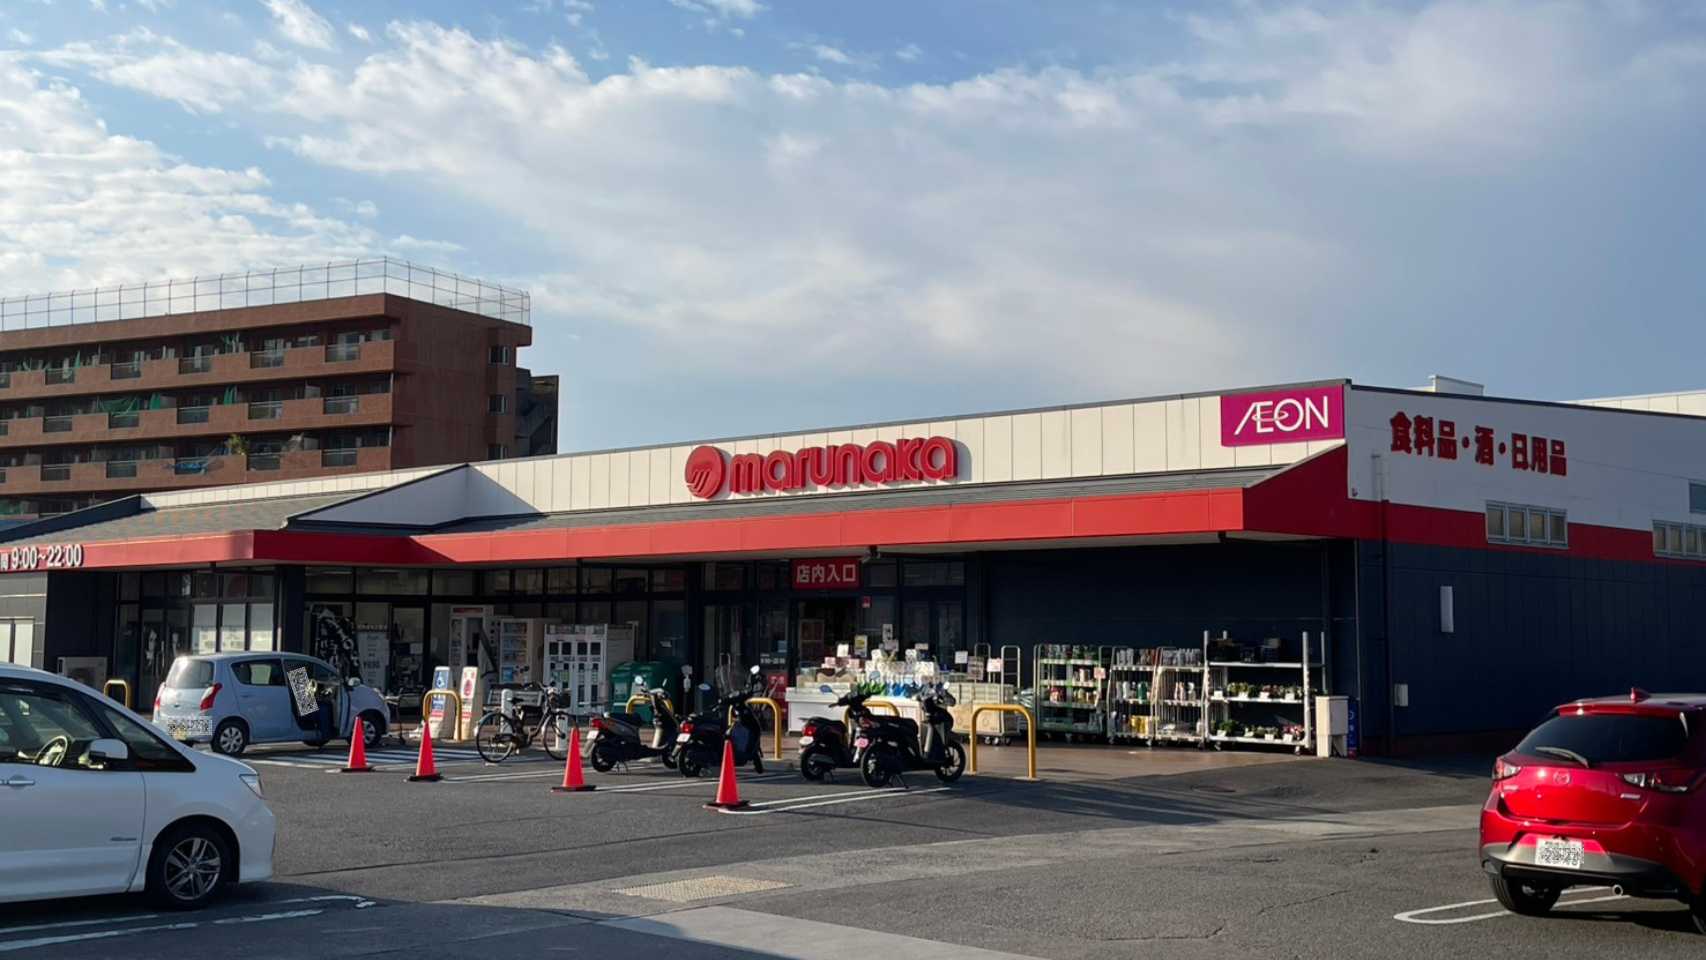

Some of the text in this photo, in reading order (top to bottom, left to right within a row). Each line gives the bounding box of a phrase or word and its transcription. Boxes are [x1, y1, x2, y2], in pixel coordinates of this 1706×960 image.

[730, 436, 958, 493] marunaka
[1390, 411, 1567, 476] 食料品・酒・日用品
[796, 564, 857, 583] 店内入口
